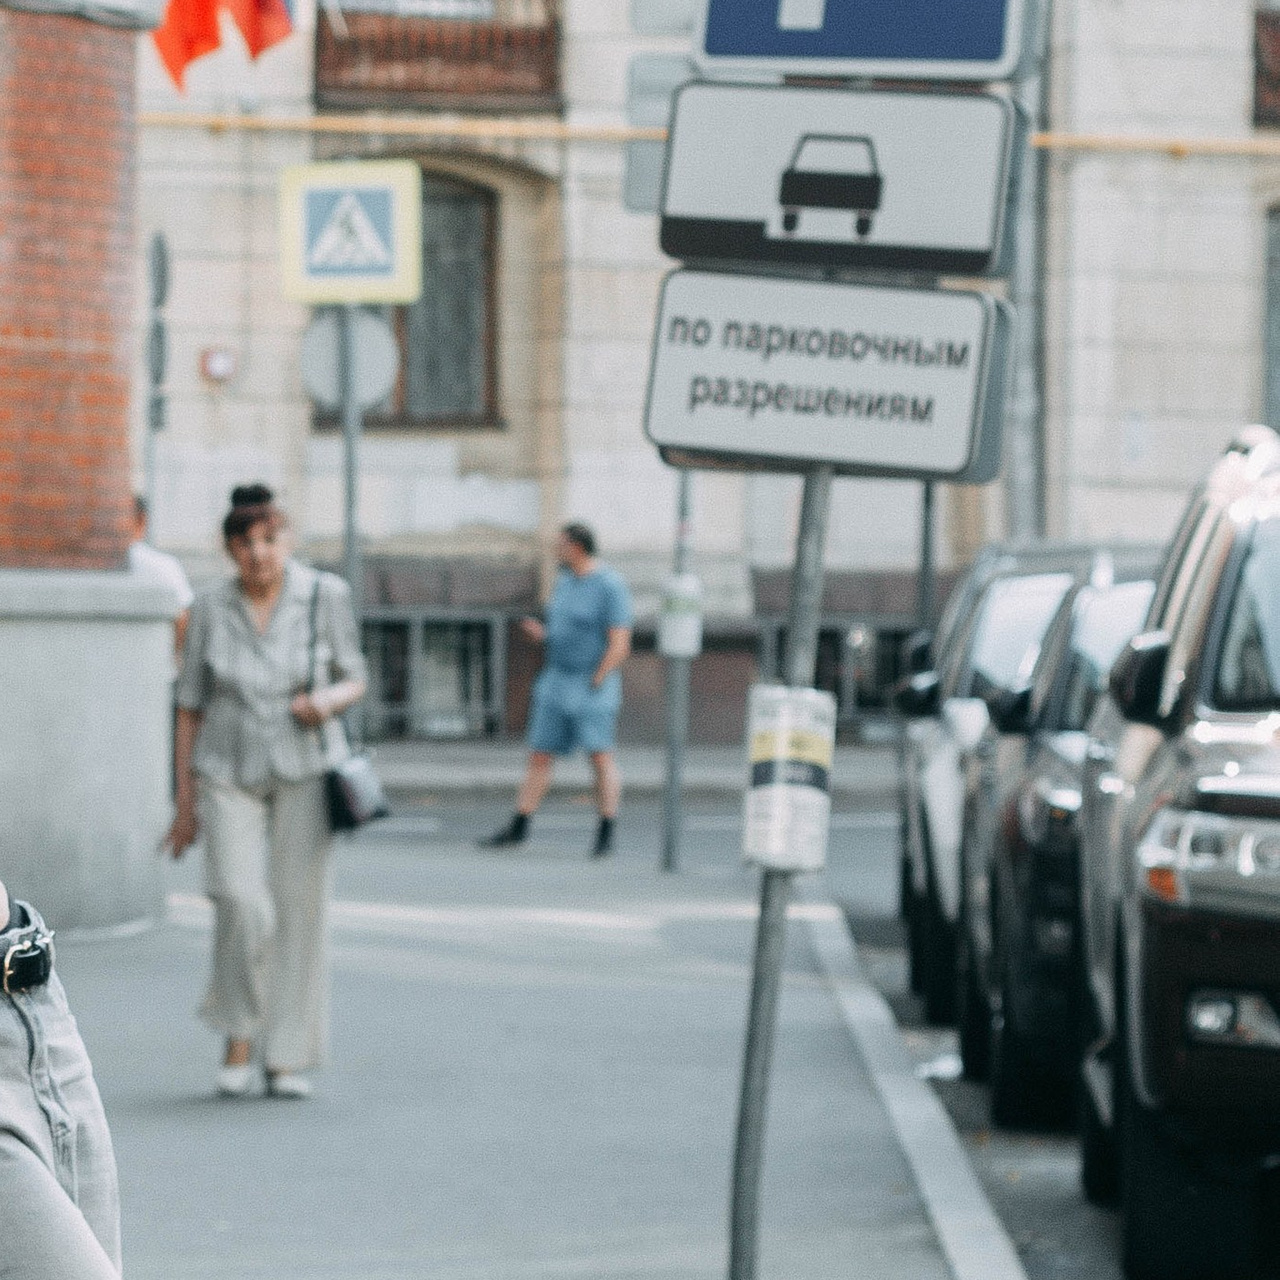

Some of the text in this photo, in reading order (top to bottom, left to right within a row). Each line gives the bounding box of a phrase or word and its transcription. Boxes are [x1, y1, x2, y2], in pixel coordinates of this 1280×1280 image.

[669, 316, 970, 366] по парковочным
[689, 375, 935, 422] разрешениям
